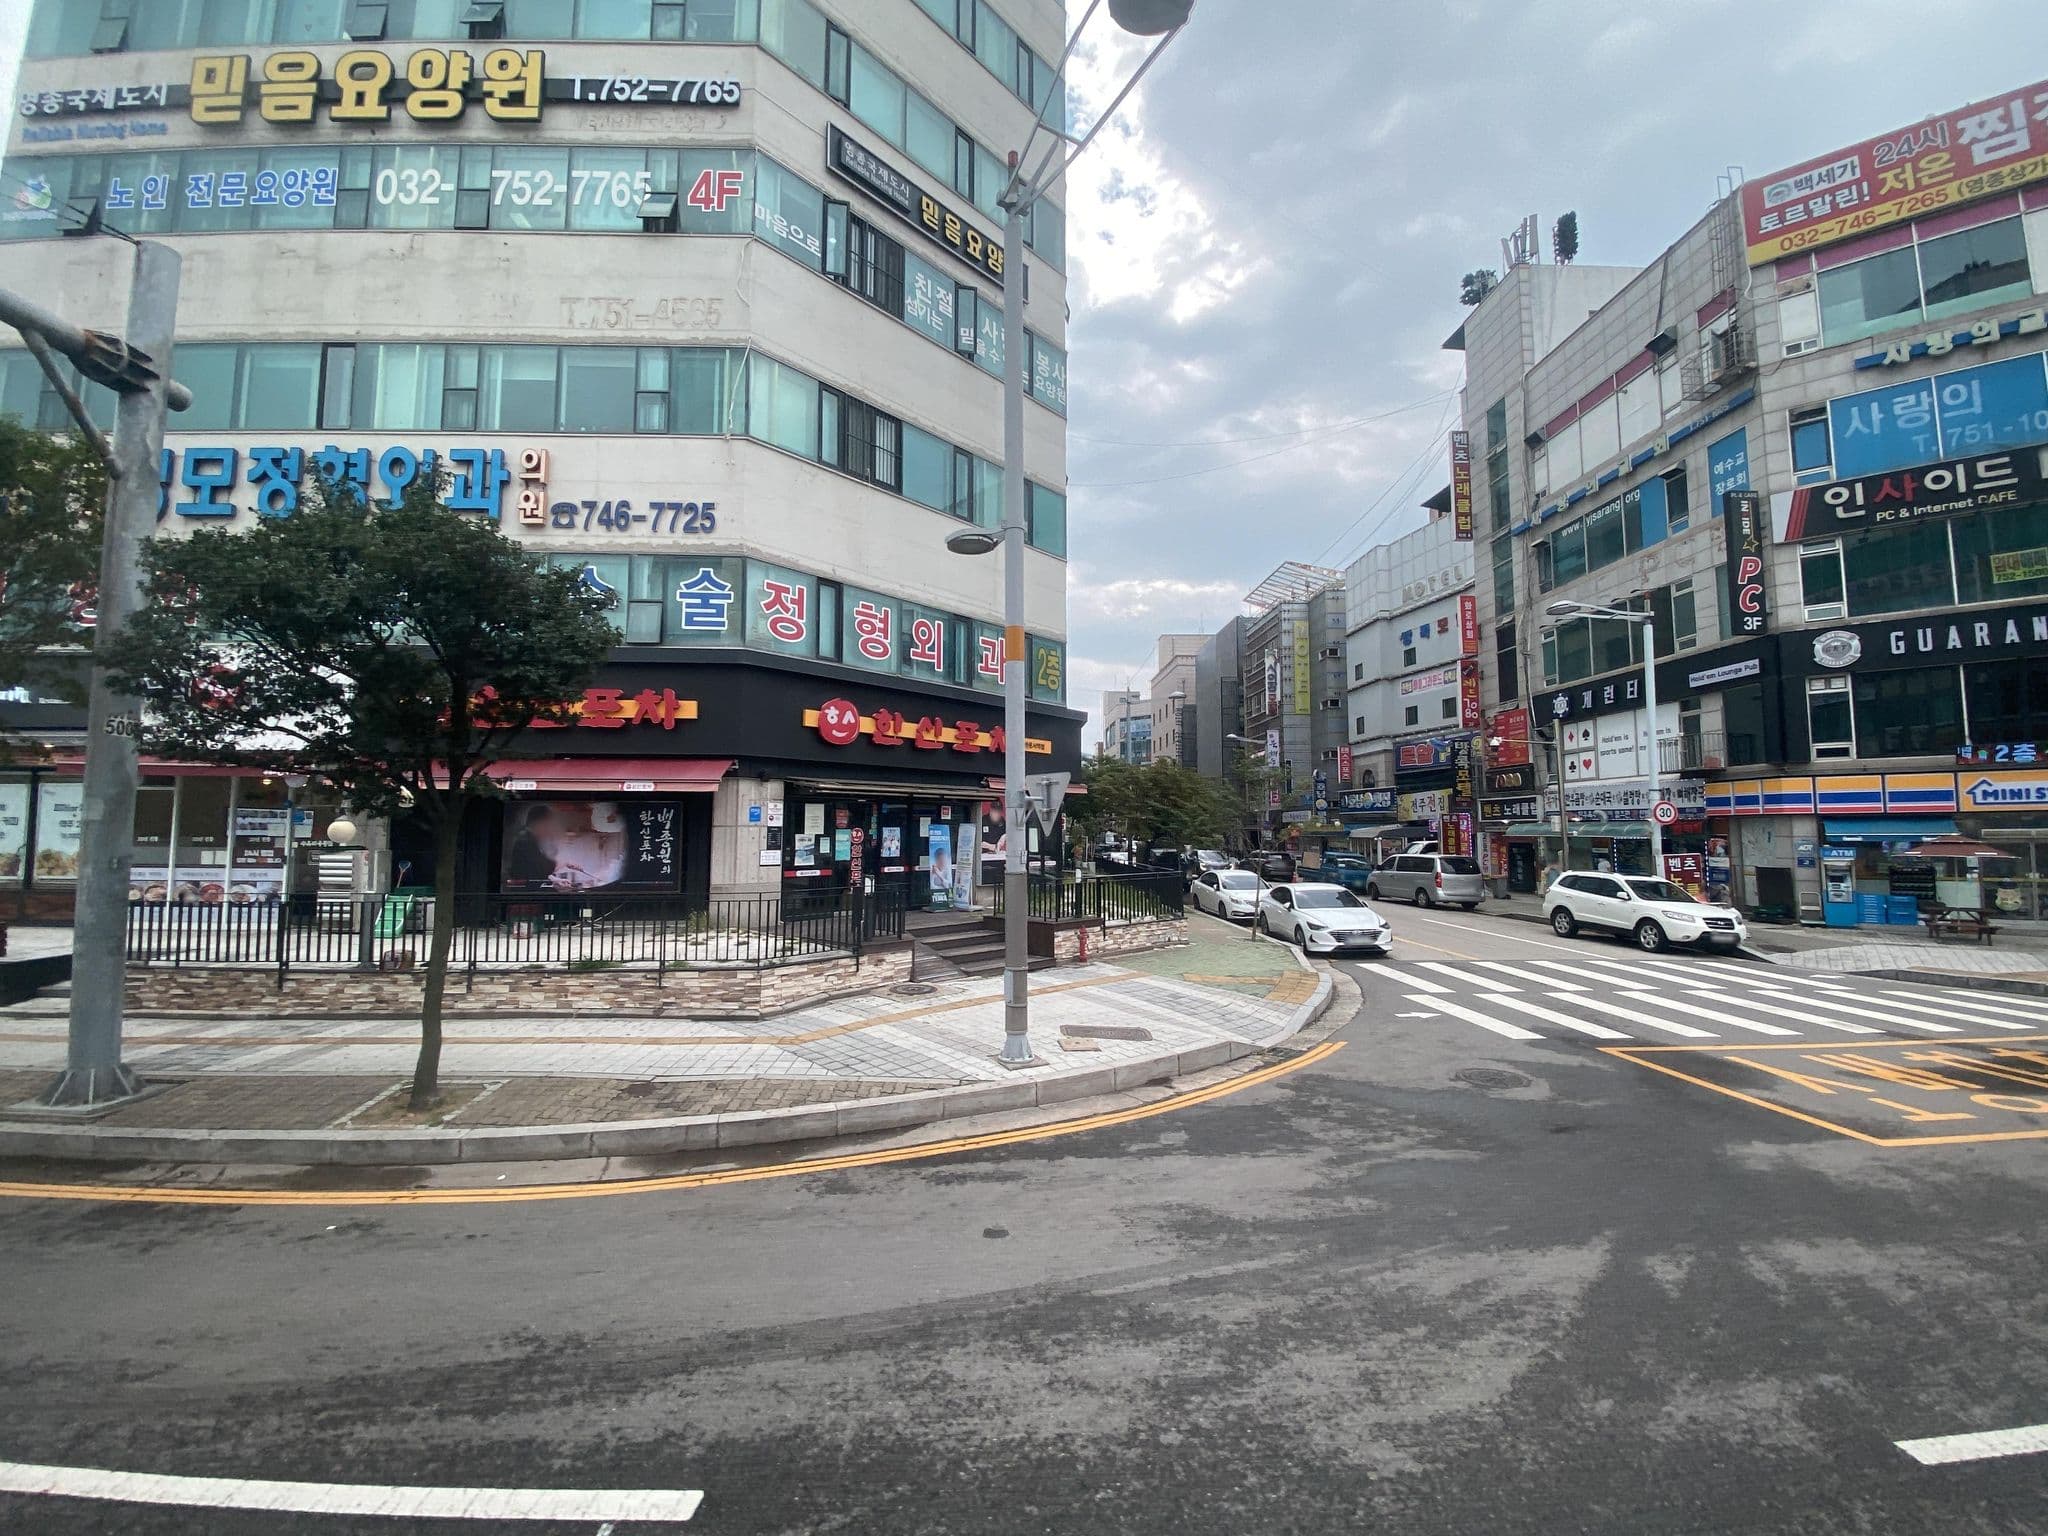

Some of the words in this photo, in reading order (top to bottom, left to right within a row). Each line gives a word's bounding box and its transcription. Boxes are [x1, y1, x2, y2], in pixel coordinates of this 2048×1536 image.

[190, 48, 546, 125] 믿음요양원
[1873, 121, 1950, 168] 24시
[105, 175, 169, 210] 노인
[184, 166, 339, 208] 전문요양원
[687, 169, 744, 212] 4F
[845, 141, 911, 198] 영종국제도시
[1793, 157, 1858, 193] 백세가
[1878, 152, 1956, 197] 저온
[1779, 190, 1949, 253] 032-746-7265
[754, 203, 821, 257] 마음으로
[914, 272, 953, 318] 친절
[981, 317, 1005, 346] 사
[1036, 351, 1065, 388] 봉사
[1844, 379, 1984, 438] 사랑의
[1454, 433, 1469, 464] 벤츠
[1713, 452, 1746, 475] 예수교
[158, 444, 511, 519] 모정형외과
[581, 500, 717, 533] 746-7725
[1456, 466, 1472, 530] 노래클럽
[1714, 470, 1748, 496] 장로회
[1824, 457, 2019, 519] 인사이드
[1875, 511, 1896, 522] PC
[1913, 498, 1974, 517] Internet
[1977, 489, 2018, 505] CAFE
[1738, 556, 1763, 613] PC
[761, 579, 1006, 685] 정형외과
[1743, 617, 1762, 630] 3F
[1717, 666, 1743, 680] Lounge
[1744, 660, 1759, 673] Pub
[1994, 744, 2037, 762] 2층
[1659, 808, 1672, 818] 30
[1981, 788, 2031, 801] MINI
[2035, 787, 2048, 800] S
[639, 810, 654, 862] 한신포차
[655, 807, 674, 874] 백종원의
[1830, 849, 1854, 857] ATM
[1668, 857, 1697, 872] 벤츠
